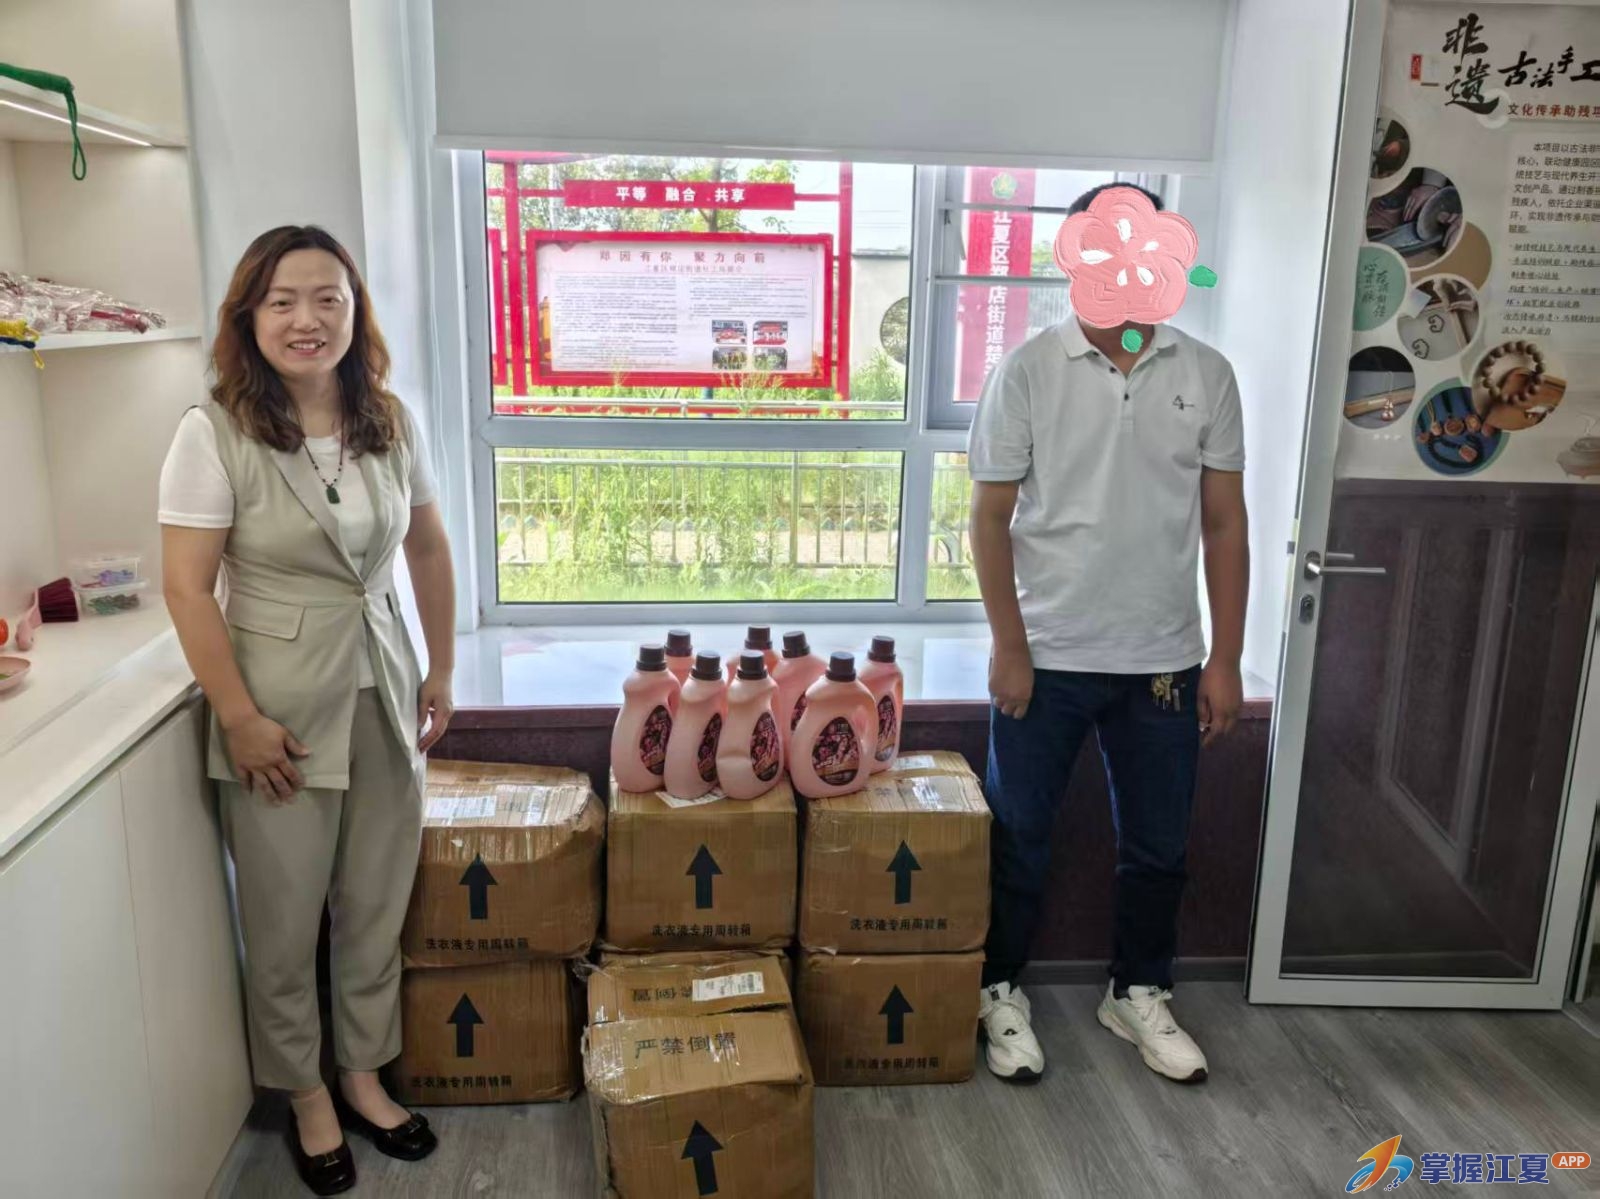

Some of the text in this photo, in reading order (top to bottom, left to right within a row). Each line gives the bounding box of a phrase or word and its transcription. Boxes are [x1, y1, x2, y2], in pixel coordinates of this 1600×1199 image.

[1442, 13, 1500, 115] 非遗
[616, 187, 745, 202] 平等 融合 共享
[652, 922, 751, 938] 洗衣液专用周转箱
[850, 917, 948, 932] 洗衣液专用周转箱
[425, 937, 530, 952] 洗衣液专用周转箱
[635, 1031, 736, 1060] 严禁倒置
